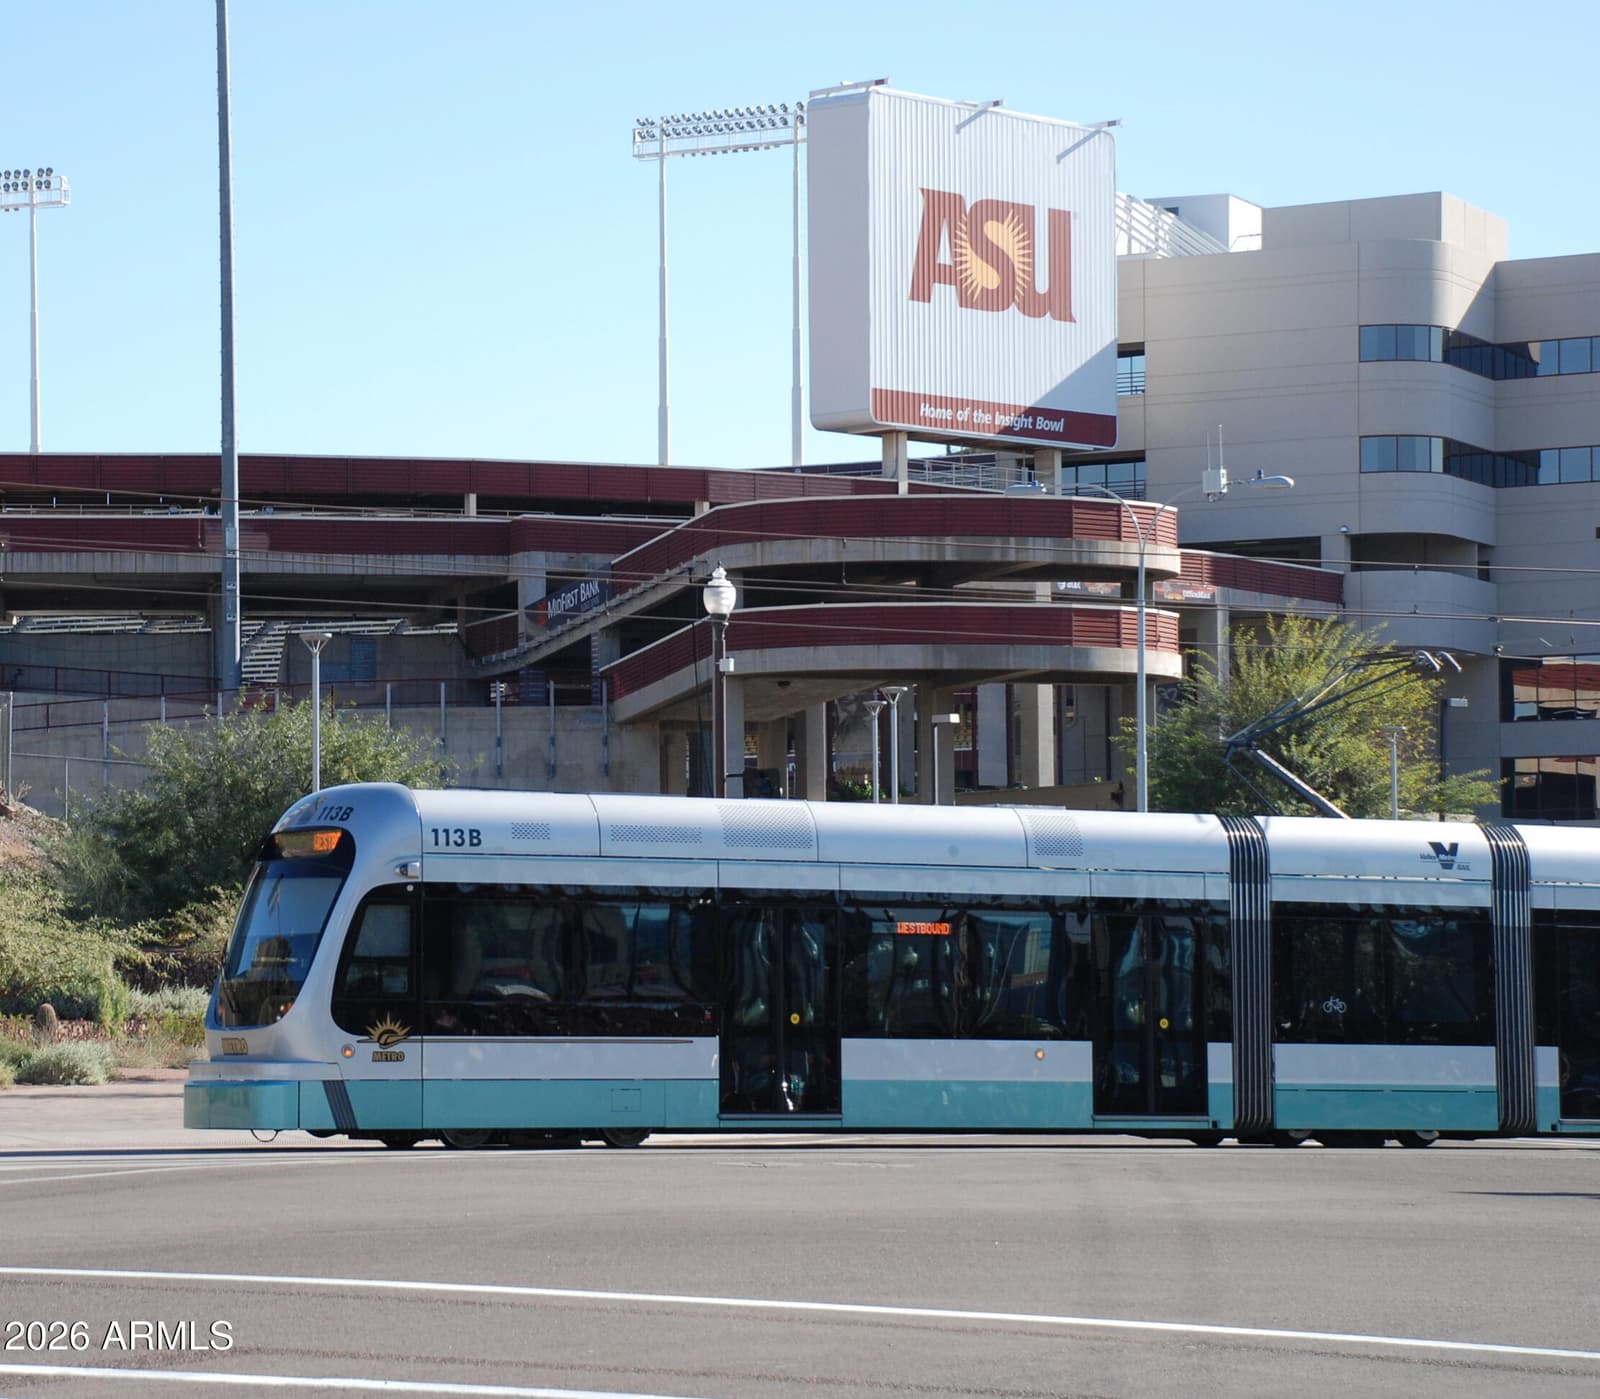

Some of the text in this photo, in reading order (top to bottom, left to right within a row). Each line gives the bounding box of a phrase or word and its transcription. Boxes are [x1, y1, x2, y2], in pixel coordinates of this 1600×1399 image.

[908, 187, 1077, 323] ASU
[920, 403, 1065, 433] Home of the Insight Bowl
[318, 806, 354, 822] 113B
[431, 828, 482, 847] 113B
[896, 921, 951, 935] WESTBOUND
[372, 1050, 405, 1063] METRO
